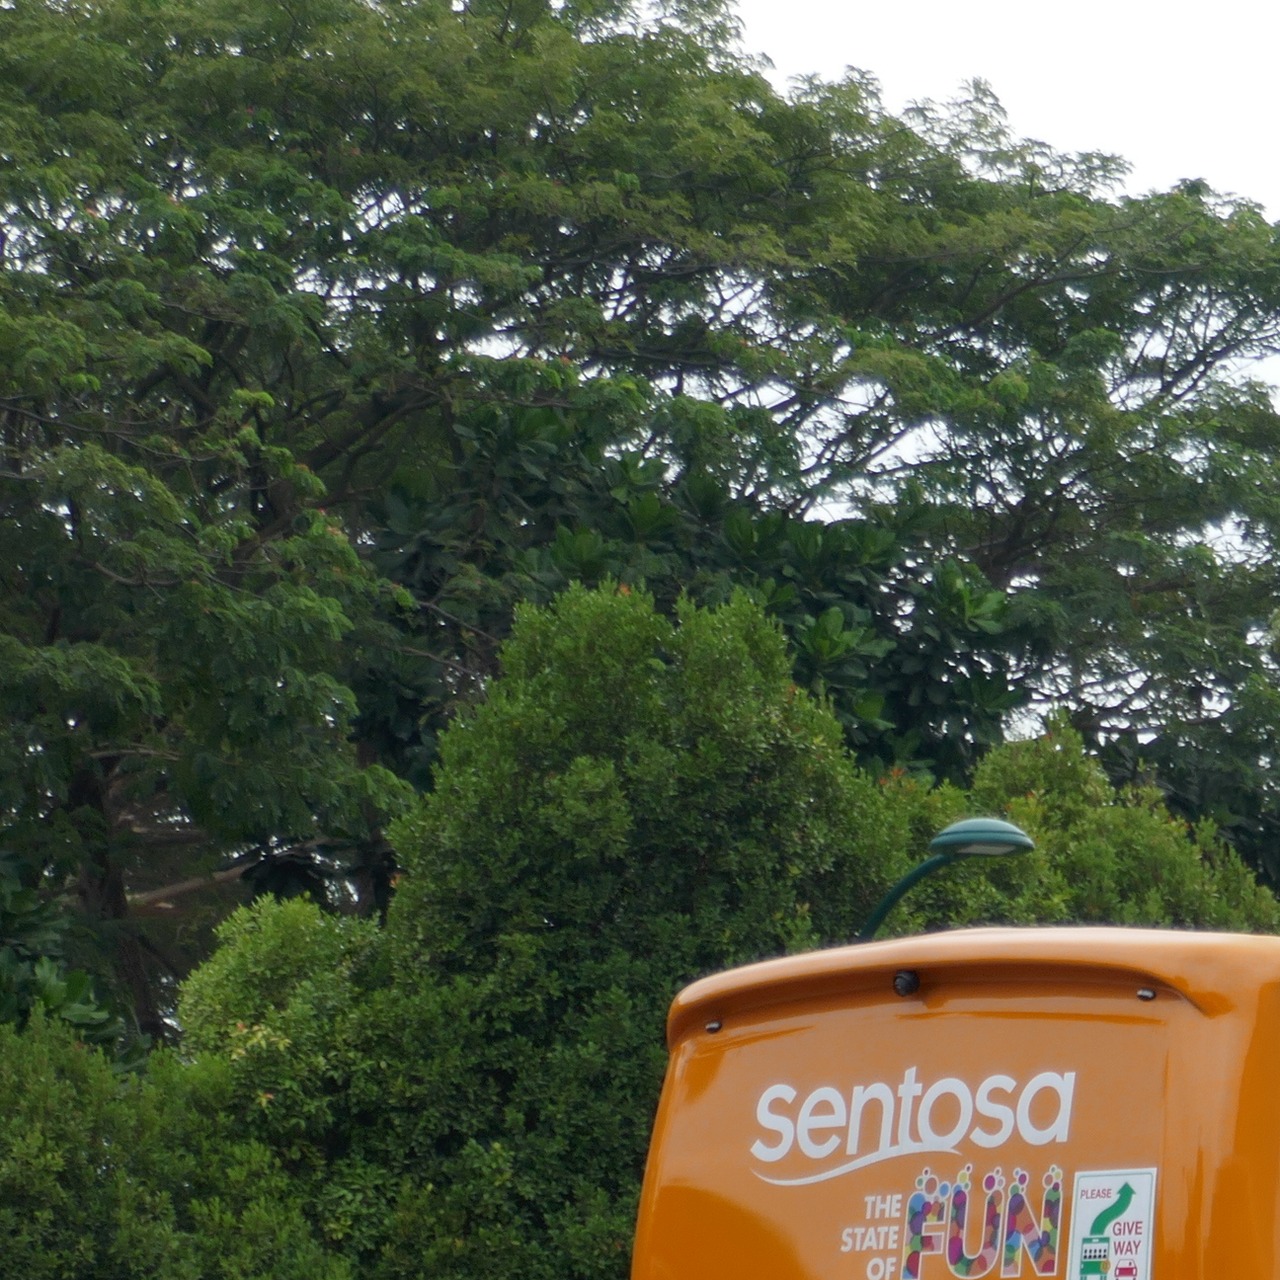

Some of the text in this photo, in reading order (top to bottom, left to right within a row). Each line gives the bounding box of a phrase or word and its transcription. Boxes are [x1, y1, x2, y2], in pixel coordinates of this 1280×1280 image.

[750, 1066, 1076, 1163] sentosa
[1080, 1188, 1112, 1200] PLEASE
[864, 1194, 903, 1220] THE
[840, 1225, 900, 1253] STATE
[1112, 1221, 1143, 1237] GIVE
[1113, 1240, 1142, 1256] WAY
